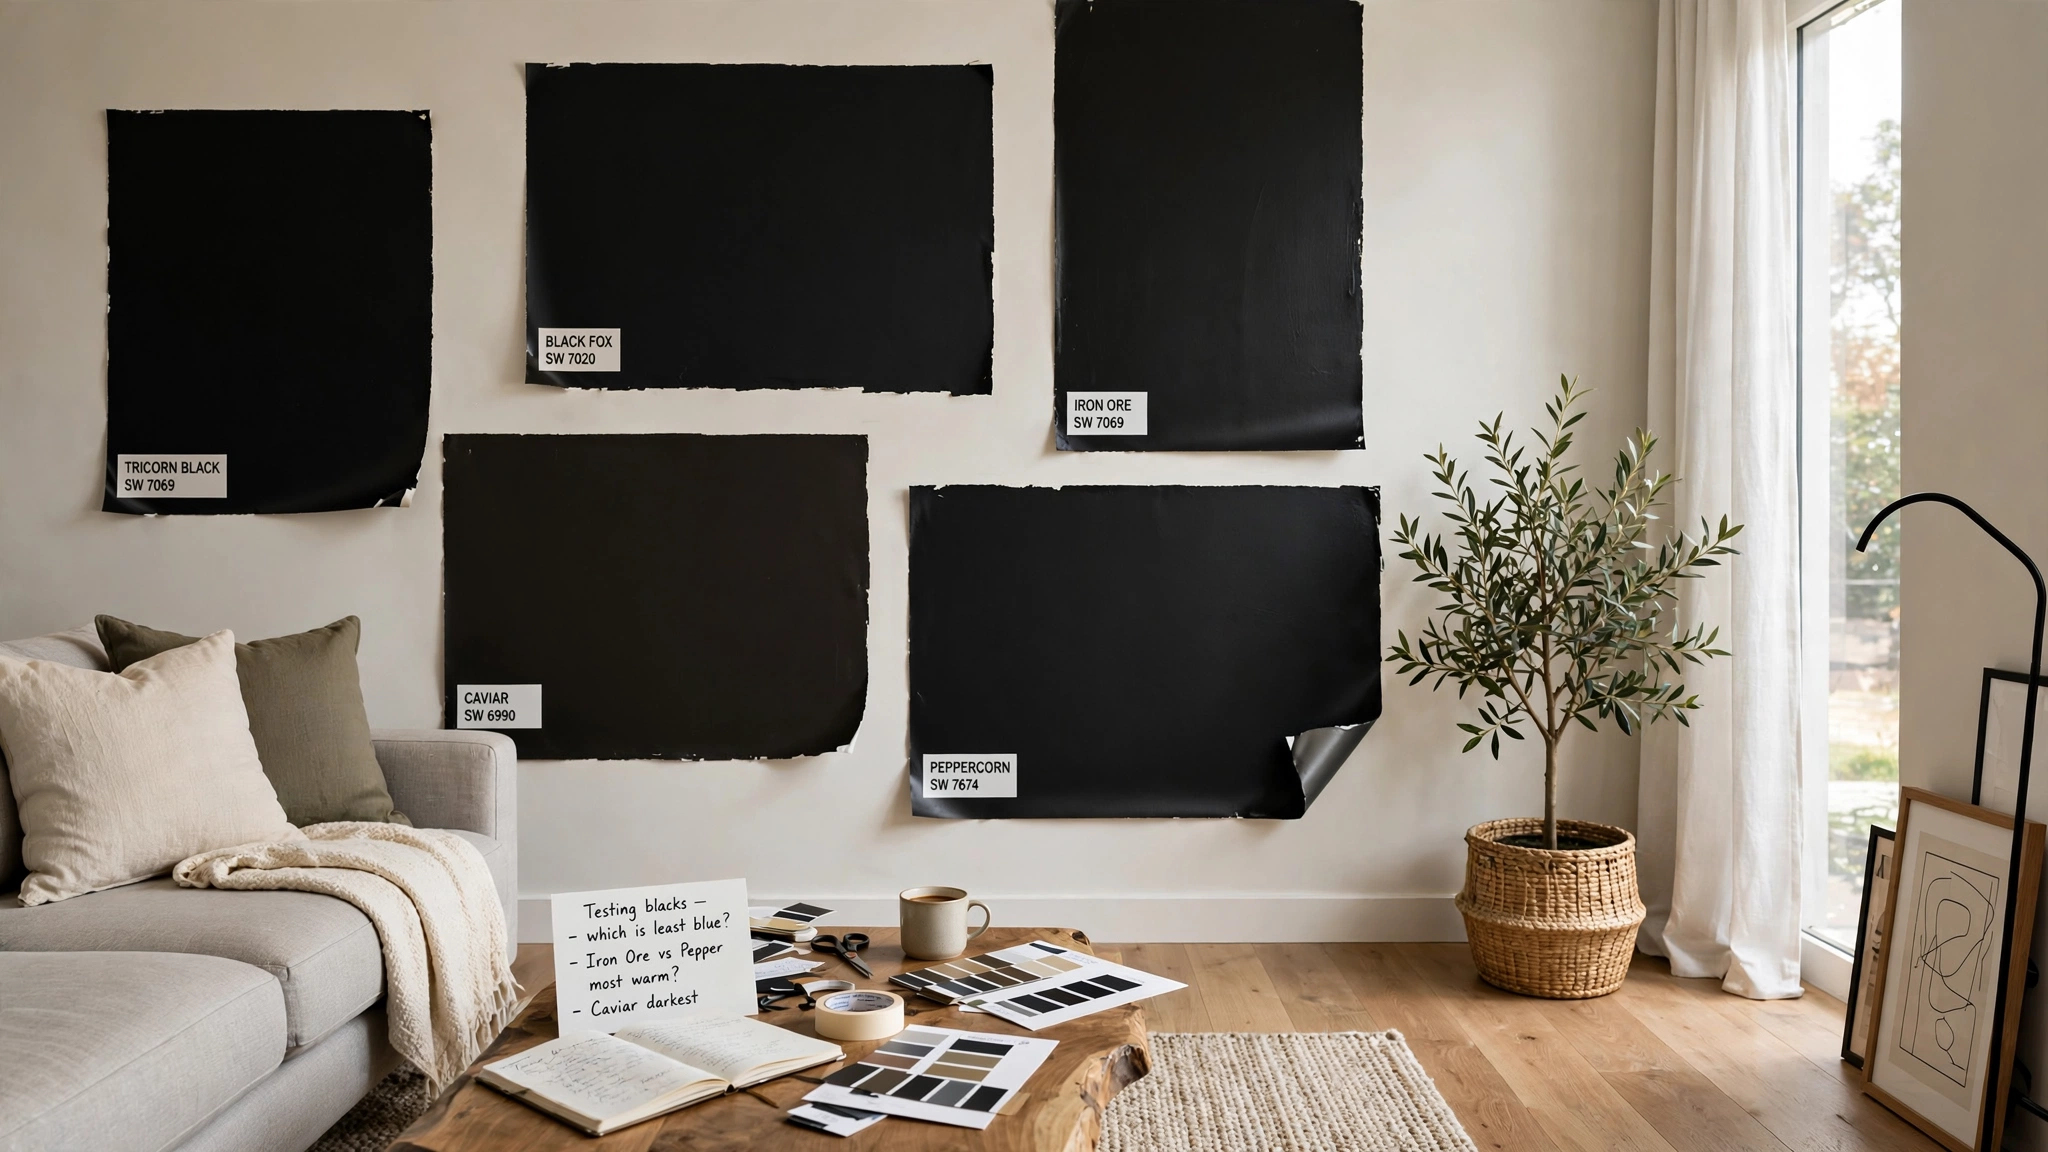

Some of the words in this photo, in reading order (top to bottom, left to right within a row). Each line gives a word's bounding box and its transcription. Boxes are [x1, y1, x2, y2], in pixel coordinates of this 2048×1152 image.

[546, 335, 586, 348] BLACK
[589, 335, 613, 348] FOX
[545, 352, 565, 365] SW
[568, 352, 596, 365] 7020
[1074, 399, 1104, 412] IRON
[1107, 399, 1132, 412] ORE
[1073, 416, 1093, 429] SW
[1096, 416, 1124, 429] 7069
[124, 461, 177, 474] TRICORN
[181, 461, 220, 474] BLACK
[124, 478, 144, 491] SW
[147, 478, 175, 491] 7069
[464, 692, 509, 704] CAVIAR
[464, 709, 484, 722] SW
[487, 709, 516, 722] 6990
[930, 761, 1011, 774] PEPPERCORN
[930, 778, 949, 791] SW
[952, 778, 979, 791] 7674
[583, 902, 637, 922] Testing
[645, 896, 687, 913] blacks
[586, 925, 627, 942] which
[635, 924, 646, 937] is
[653, 919, 687, 935] least
[693, 911, 731, 931] blue?
[586, 952, 618, 969] Iron
[625, 949, 650, 964] Ore
[658, 949, 672, 959] vs
[680, 941, 723, 961] Pepper
[589, 974, 623, 991] most
[631, 965, 680, 986] warm?
[591, 999, 638, 1017] Caviar
[646, 989, 699, 1010] darkest
